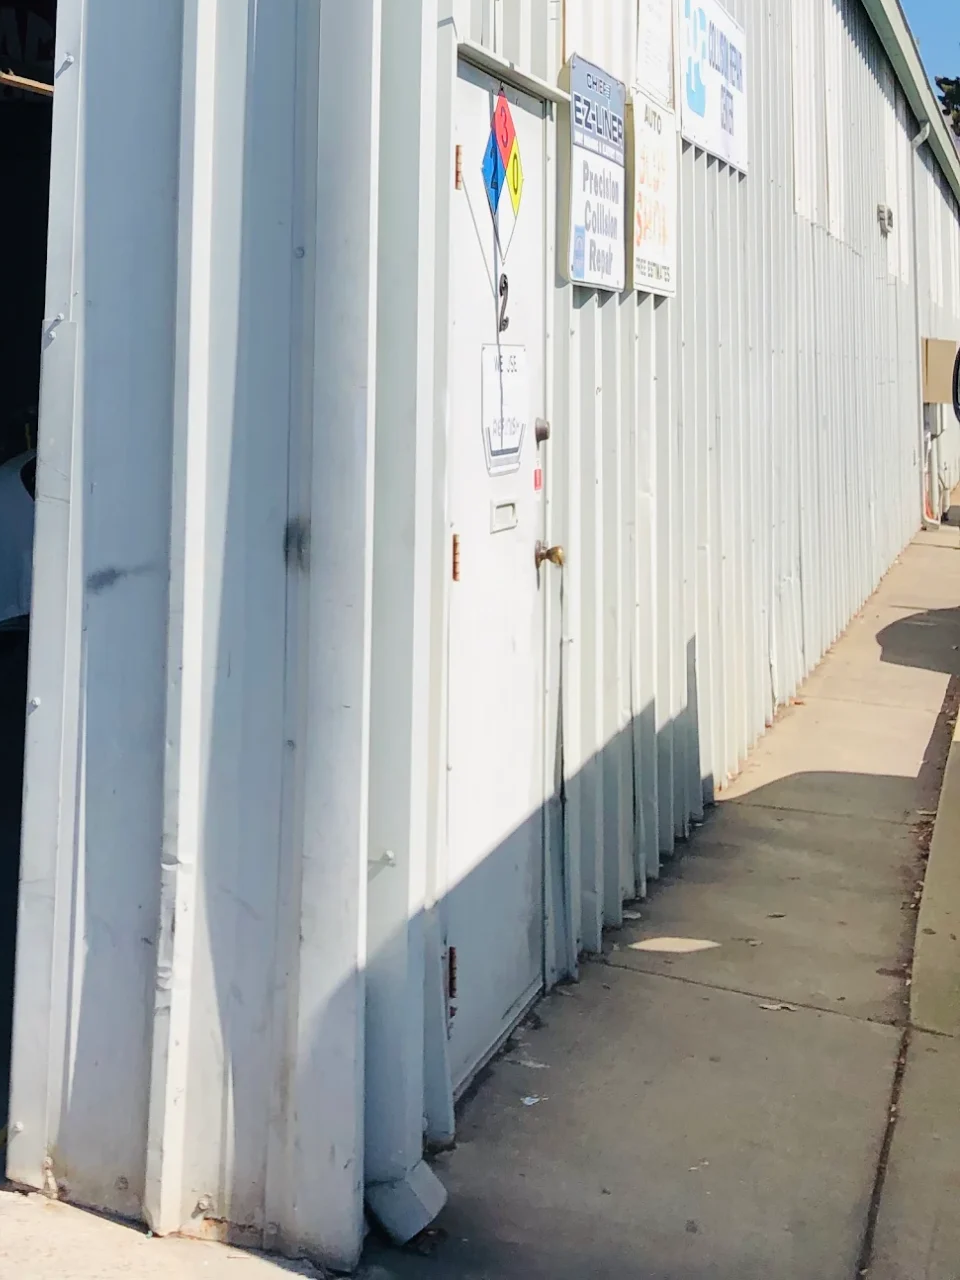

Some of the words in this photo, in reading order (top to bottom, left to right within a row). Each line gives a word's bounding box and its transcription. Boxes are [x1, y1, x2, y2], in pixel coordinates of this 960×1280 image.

[500, 105, 509, 148] 3
[644, 103, 662, 135] AUTO
[490, 146, 498, 190] 2
[512, 152, 519, 196] 0
[582, 160, 619, 205] Precision
[585, 200, 618, 240] Collision
[589, 239, 613, 279] Repair
[499, 273, 509, 333] 2
